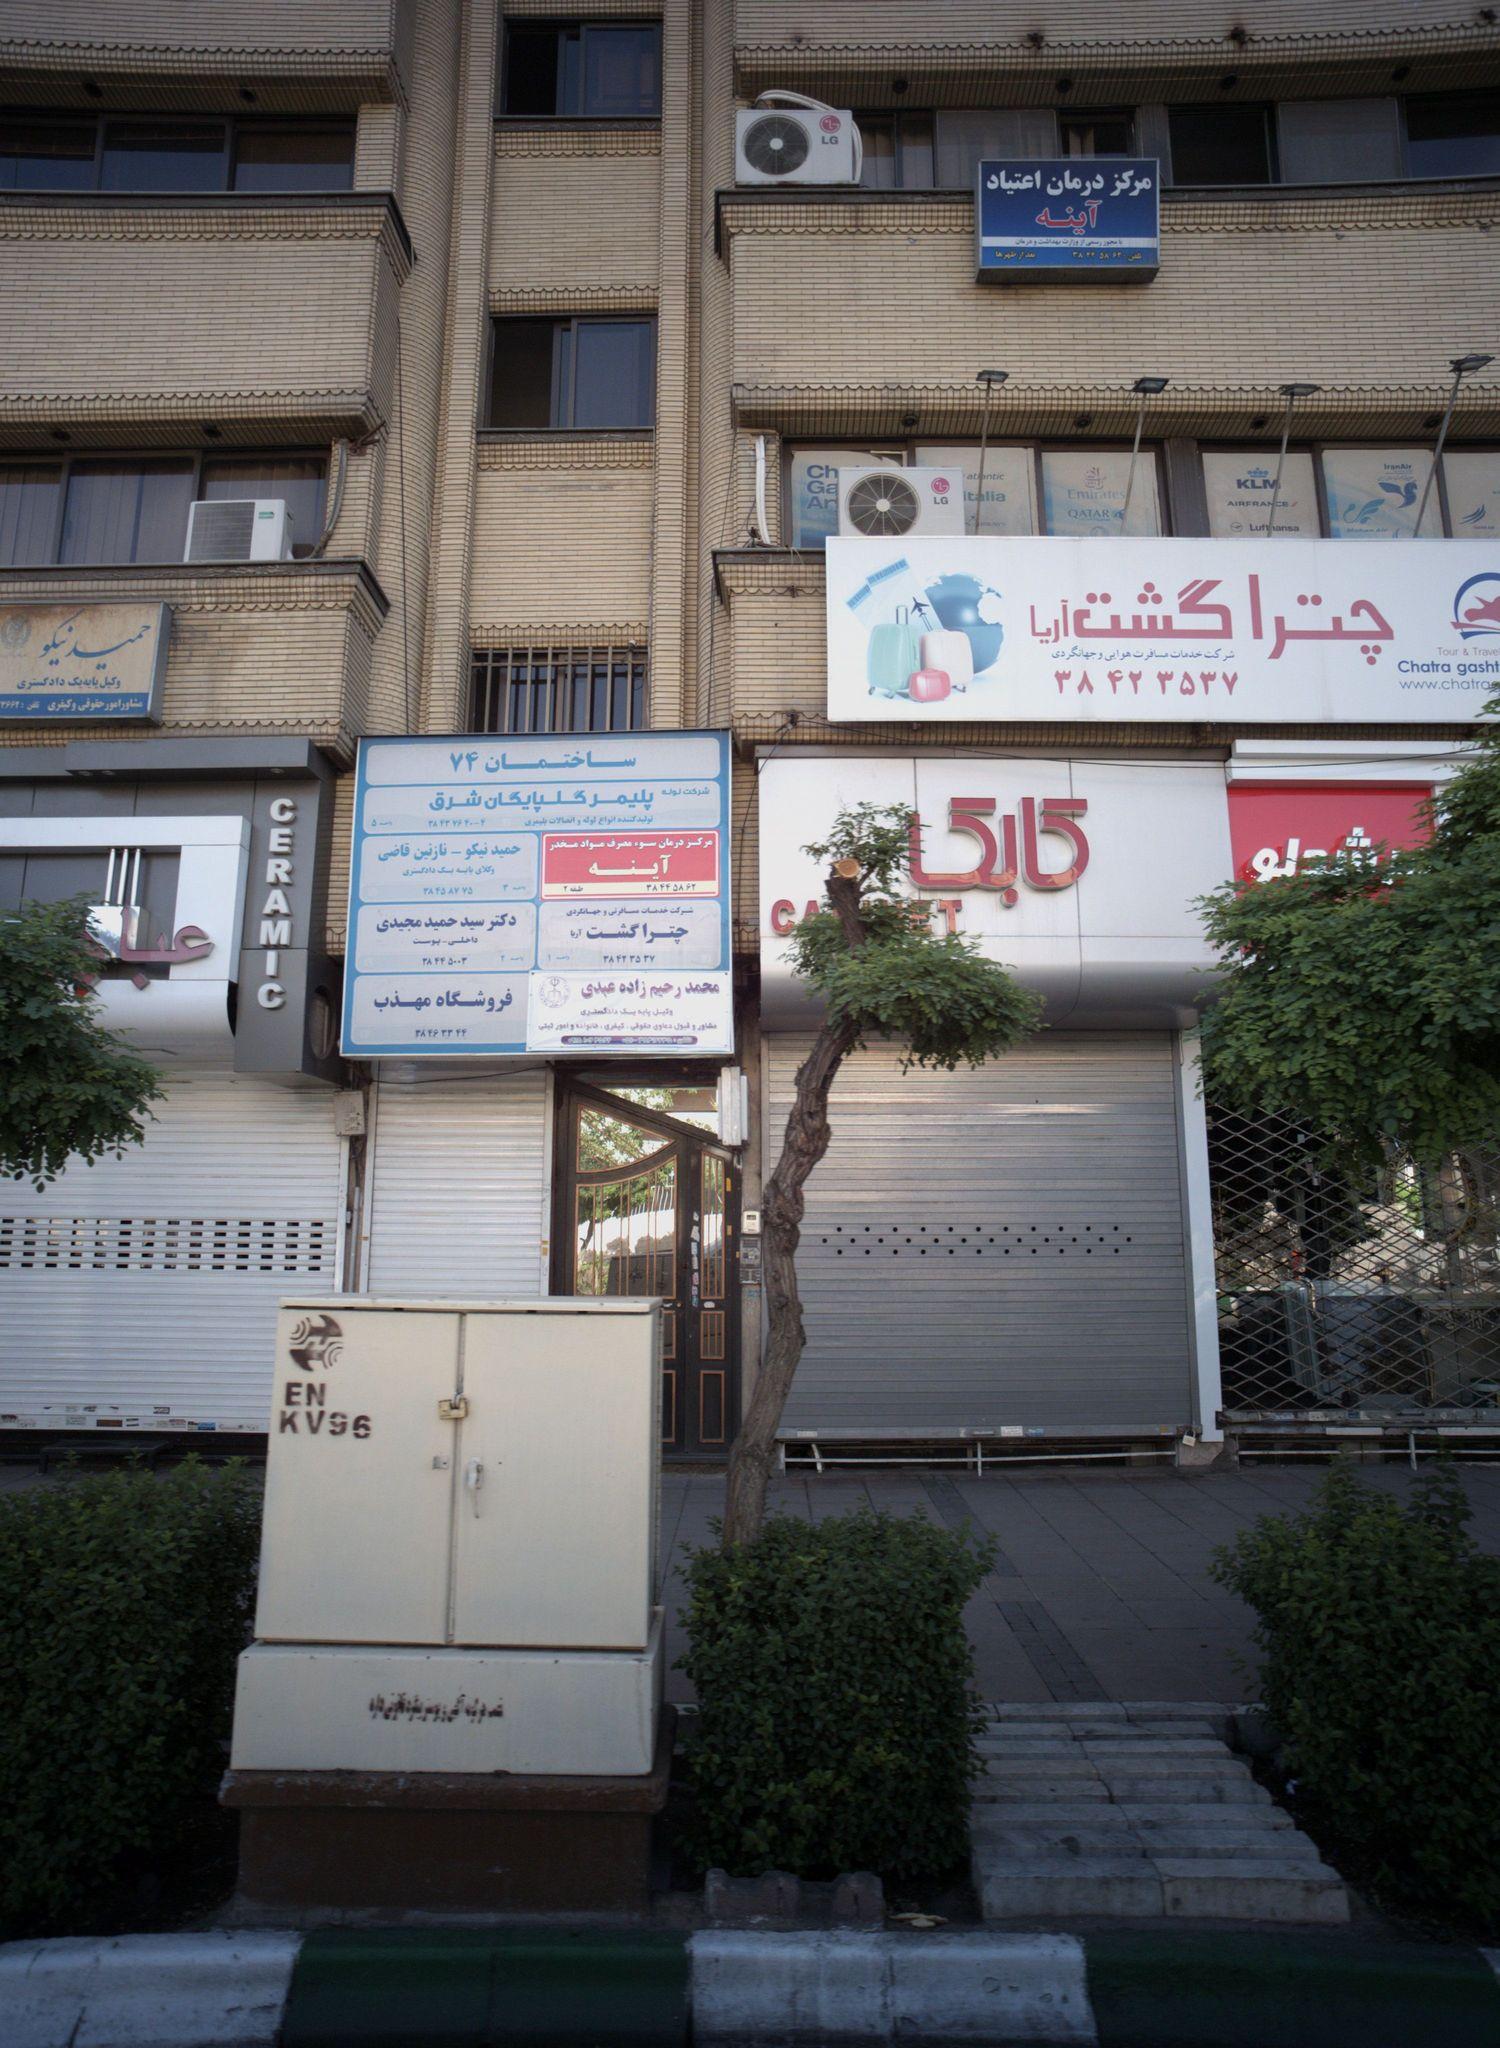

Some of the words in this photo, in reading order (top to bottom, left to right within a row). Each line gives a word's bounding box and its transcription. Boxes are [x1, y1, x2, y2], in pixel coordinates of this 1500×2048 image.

[821, 136, 839, 145] LG
[986, 169, 1041, 195] اعتیاد
[1046, 170, 1104, 196] درمان
[1109, 170, 1152, 196] مرکز
[1035, 199, 1103, 235] آینه
[1038, 238, 1061, 246] بهداشت
[1063, 239, 1079, 247] وزارت
[1236, 479, 1281, 490] KLM
[933, 496, 949, 505] LG
[1068, 508, 1110, 520] QATAR
[1073, 579, 1234, 640] گشت
[1030, 599, 1069, 644] آریا
[1248, 574, 1395, 666] چترا
[39, 608, 85, 666] نیکو
[65, 625, 152, 670] حمید
[1051, 645, 1097, 661] جهانگردی
[1171, 649, 1203, 660] خدمات
[1204, 648, 1236, 662] شرکت
[1436, 646, 1458, 656] Tour
[1462, 648, 1469, 656] &
[1397, 660, 1451, 674] Chatra
[1456, 660, 1500, 676] gasht
[16, 676, 66, 690] دادگستری
[100, 676, 121, 689] وکیل
[1054, 670, 1095, 695] ۳۸
[1106, 669, 1143, 695] ۴۲
[1156, 670, 1239, 696] ۳۵۳۷
[450, 751, 479, 773] ۷۴
[484, 751, 637, 773] ساختمان
[589, 788, 654, 811] پلیمر
[661, 787, 681, 796] لوله
[682, 787, 710, 797] شرکت
[429, 790, 482, 811] شرق
[484, 789, 587, 813] گلپایگان
[549, 816, 575, 825] اتصالات
[582, 816, 596, 825] لوله
[598, 815, 616, 826] انواع
[464, 841, 488, 860] نیکو
[491, 843, 522, 859] حمید
[550, 840, 579, 851] مخدر
[580, 839, 605, 850] مواد
[607, 838, 632, 850] مصرف
[634, 839, 656, 850] سوء
[658, 838, 684, 849] درمان
[685, 837, 713, 849] مرکز
[378, 842, 410, 862] قاضی
[414, 842, 447, 861] نازنین
[402, 866, 436, 877] دادگستری
[588, 854, 672, 880] آینه
[257, 798, 296, 1009] CERAMIC
[641, 907, 668, 915] خدمات
[670, 906, 694, 915] شرکت
[566, 908, 601, 917] جهانگردی
[608, 907, 639, 917] مسافرتی
[376, 915, 422, 933] مجیدی
[424, 914, 458, 931] حمید
[460, 915, 485, 931] سید
[486, 913, 516, 932] دکتر
[570, 928, 582, 939] آریا
[586, 923, 639, 940] گشت
[642, 923, 689, 945] چترا
[413, 937, 441, 946] پوست
[448, 936, 479, 946] داخلی
[581, 981, 615, 999] عبدی
[619, 978, 646, 999] زاده
[650, 981, 682, 999] رحیم
[685, 981, 720, 995] محمد
[374, 990, 431, 1012] مهذب
[436, 988, 513, 1012] فروشگاه
[285, 1382, 326, 1406] EN
[279, 1410, 371, 1439] KV96
